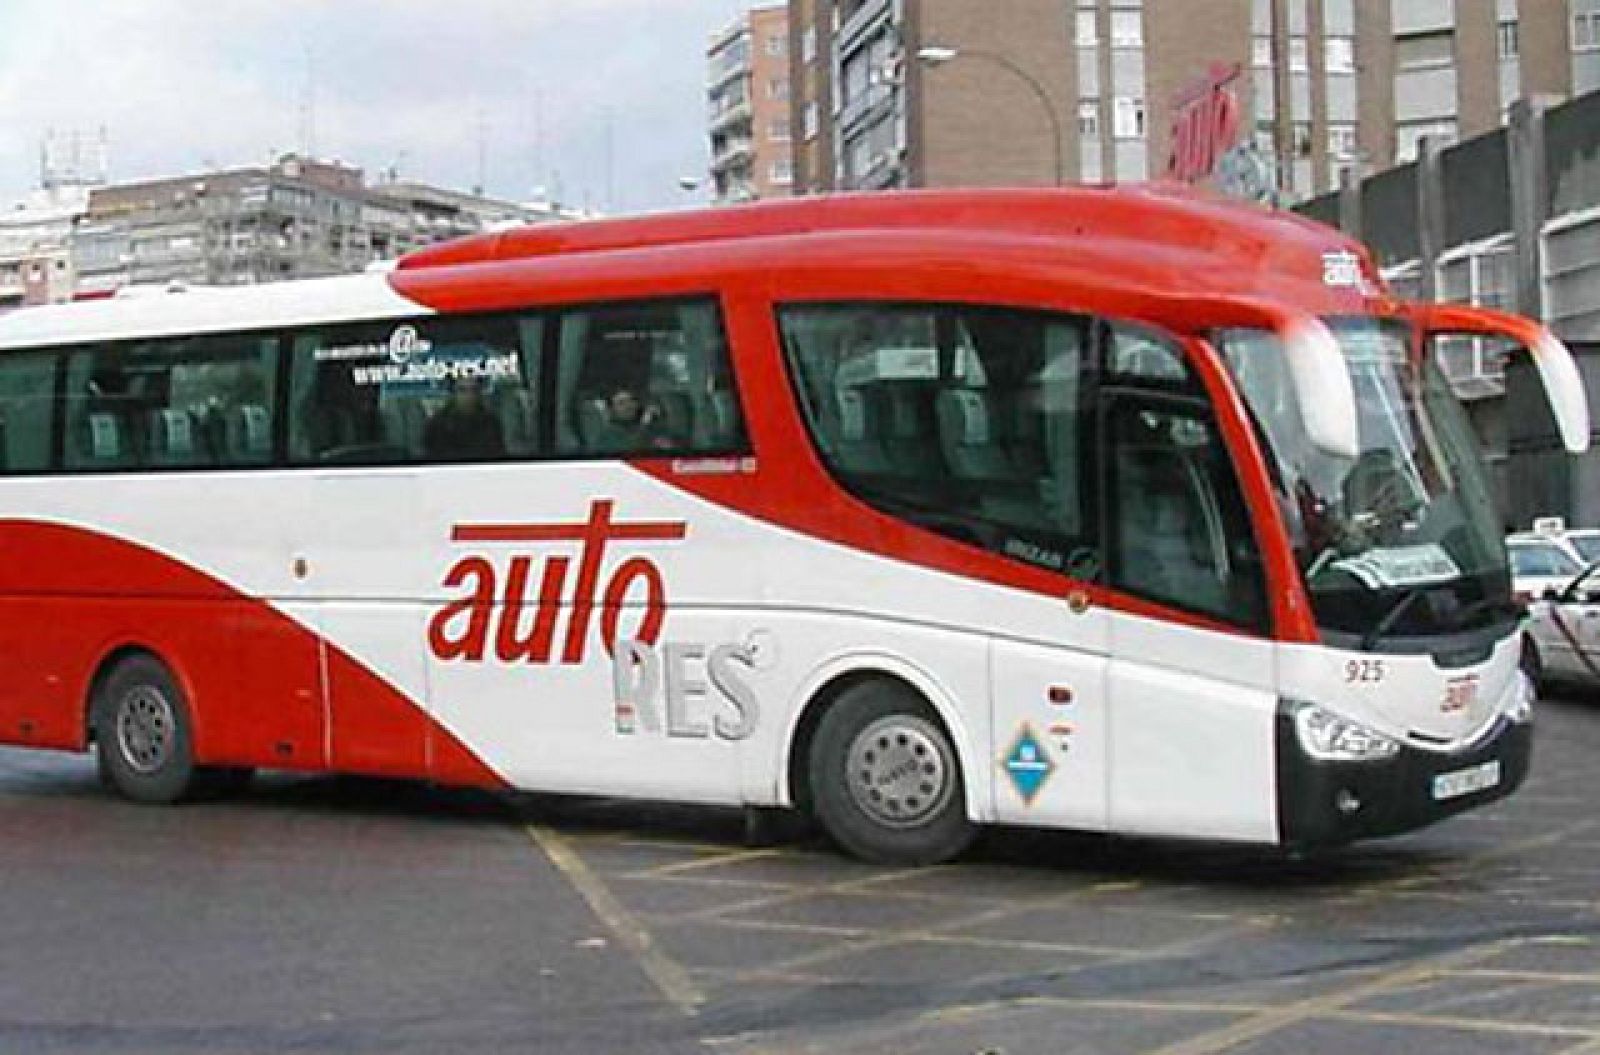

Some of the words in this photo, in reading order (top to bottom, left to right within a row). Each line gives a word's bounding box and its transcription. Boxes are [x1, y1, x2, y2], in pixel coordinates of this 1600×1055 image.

[427, 499, 687, 665] auto
[613, 638, 760, 741] RES
[1345, 659, 1383, 683] 925
